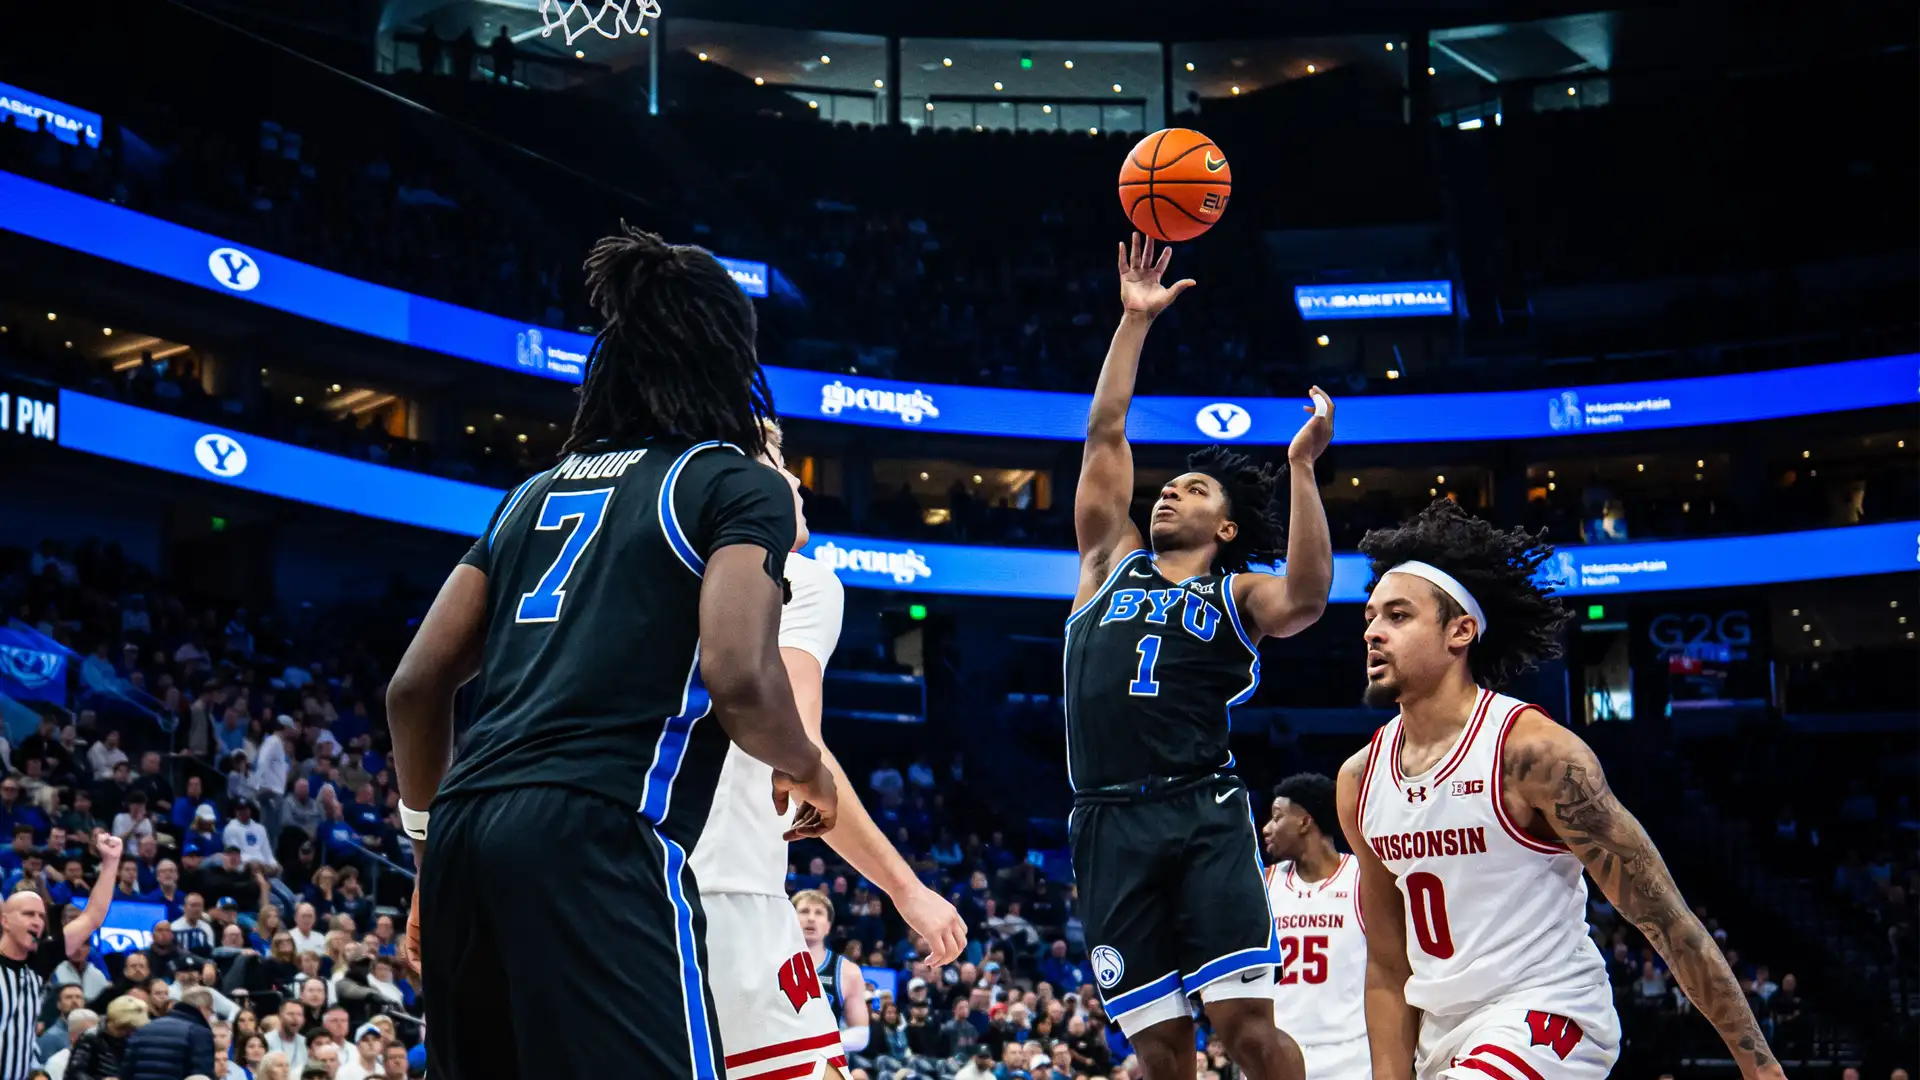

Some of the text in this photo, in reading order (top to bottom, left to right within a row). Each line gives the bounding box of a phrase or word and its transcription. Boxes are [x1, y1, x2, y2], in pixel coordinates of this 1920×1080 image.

[17, 395, 56, 441] PM
[515, 486, 616, 624] 7
[1099, 588, 1223, 642] BYU
[1128, 634, 1162, 697] 1
[1370, 826, 1487, 862] WISCONSIN
[1405, 871, 1455, 960] 0
[1279, 934, 1329, 986] 25
